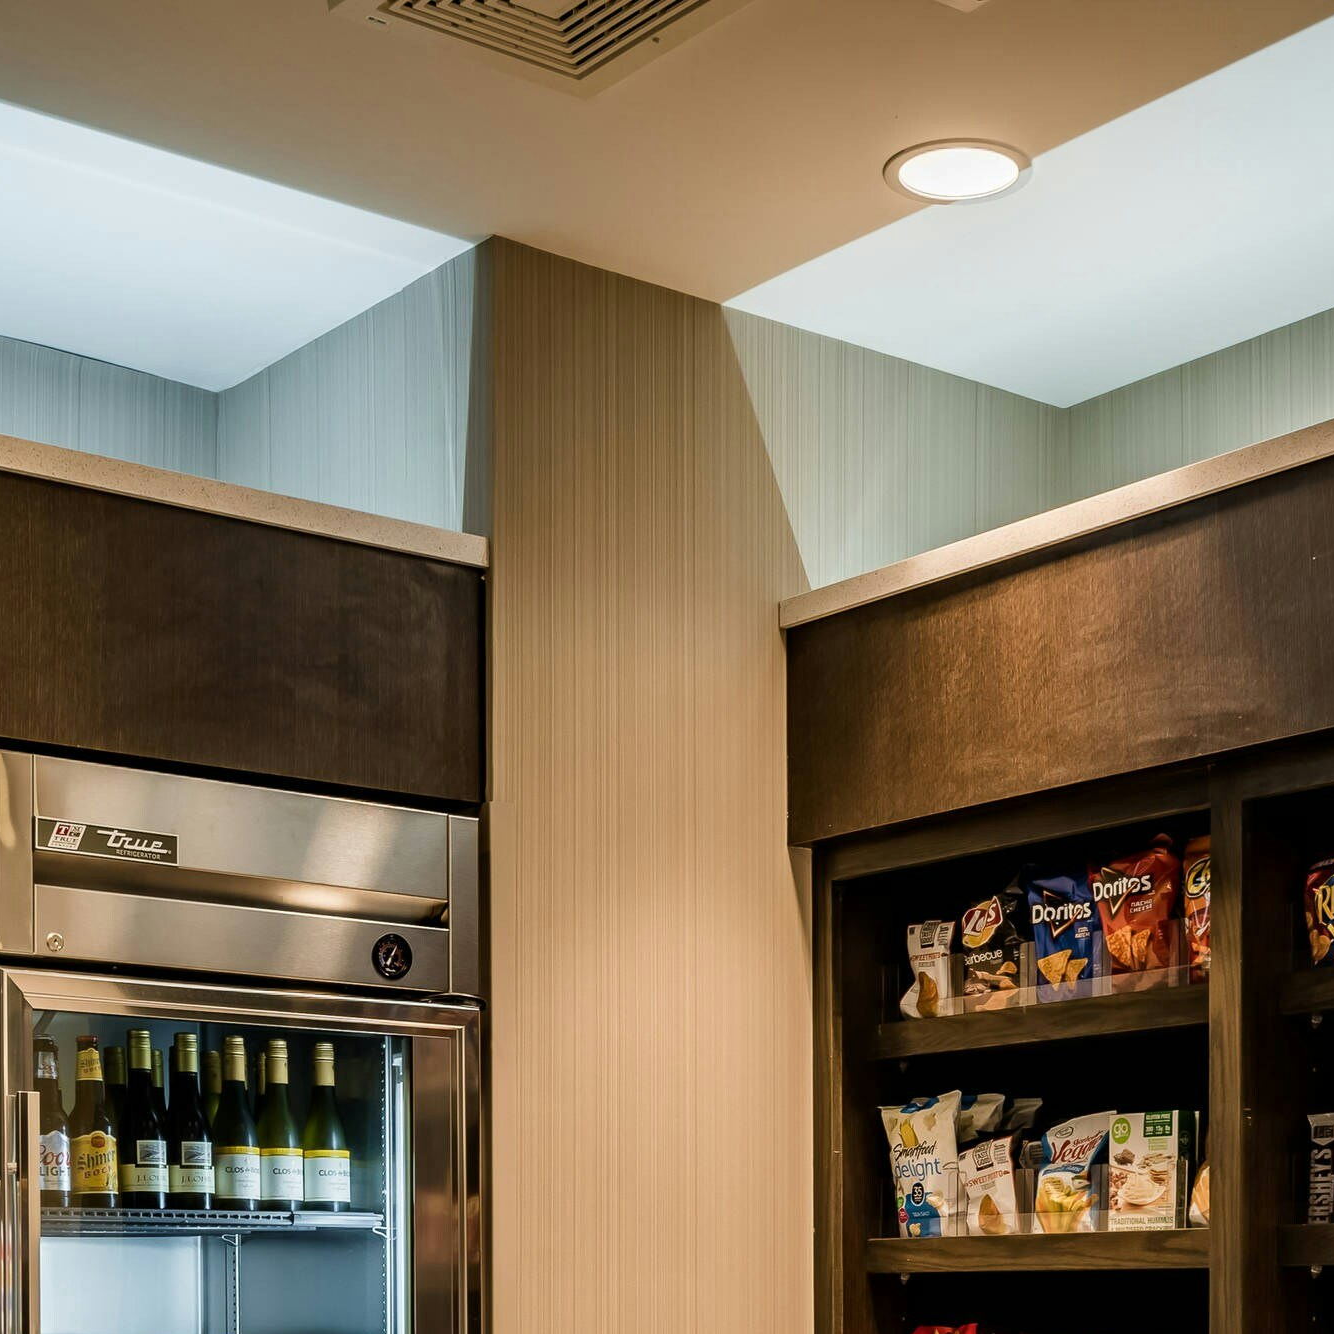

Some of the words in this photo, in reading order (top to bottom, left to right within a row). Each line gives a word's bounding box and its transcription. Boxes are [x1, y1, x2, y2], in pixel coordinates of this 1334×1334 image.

[116, 848, 161, 860] REFRIGERATOR
[1092, 873, 1152, 903] Doritos
[1129, 904, 1153, 914] CHEESE
[1130, 898, 1153, 908] NACHO
[1031, 901, 1092, 925] Doritos
[894, 1157, 942, 1181] delight
[913, 1186, 923, 1195] 35
[1308, 1148, 1333, 1225] ERSHEY'S
[1110, 1216, 1146, 1226] TRADITIONAL
